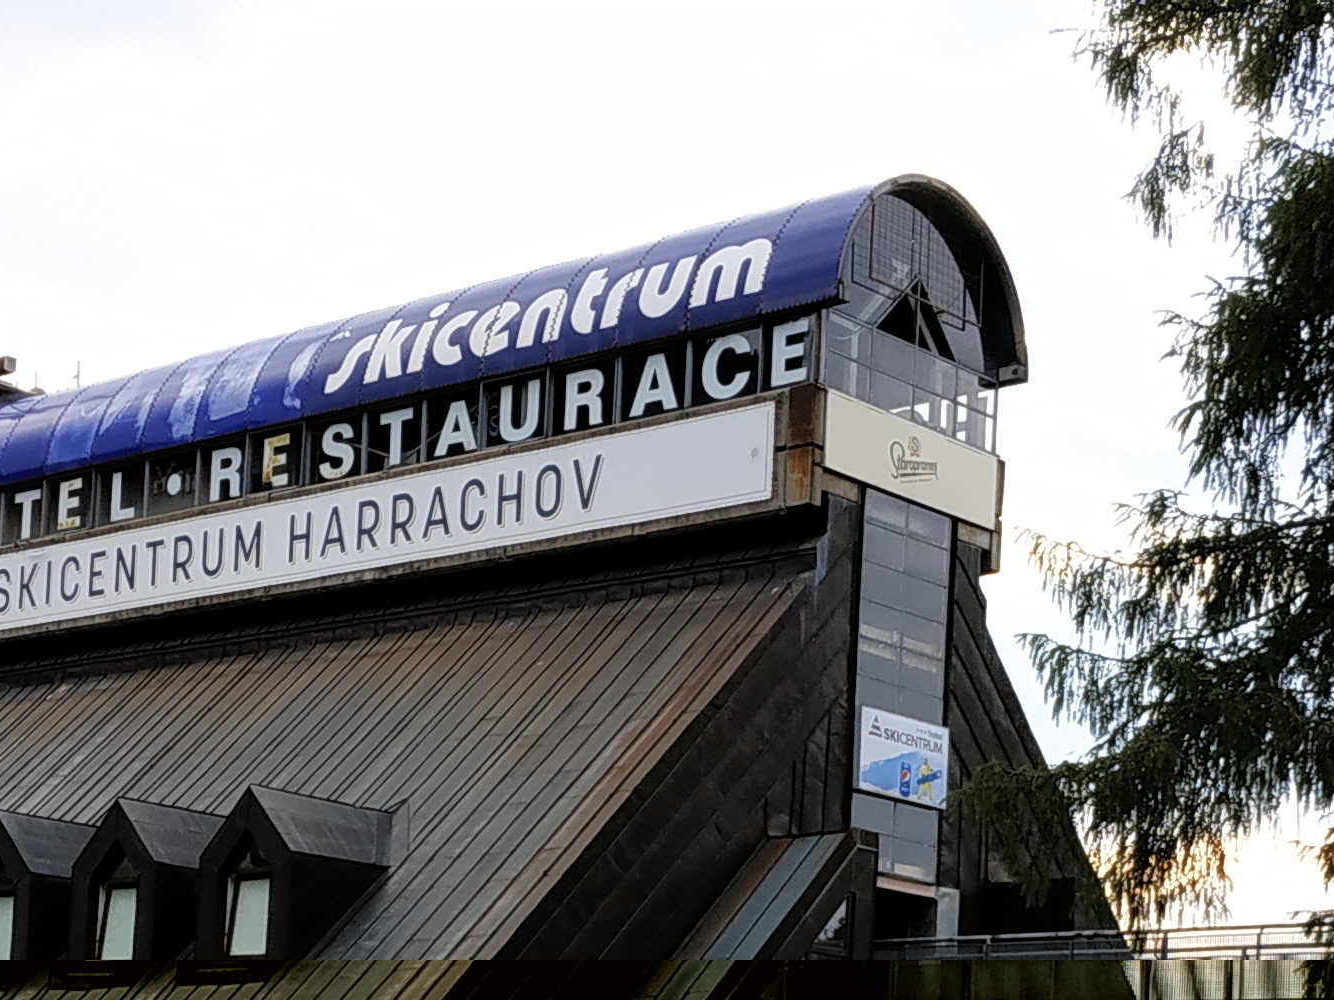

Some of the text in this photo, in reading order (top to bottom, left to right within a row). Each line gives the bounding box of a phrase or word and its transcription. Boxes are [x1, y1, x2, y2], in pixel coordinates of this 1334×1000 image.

[324, 238, 774, 395] skicentrum
[208, 318, 812, 503] RESTAURACE
[890, 441, 938, 480] Staropramen
[287, 453, 605, 564] HARRACHOV
[883, 728, 943, 755] SKICENTRUM
